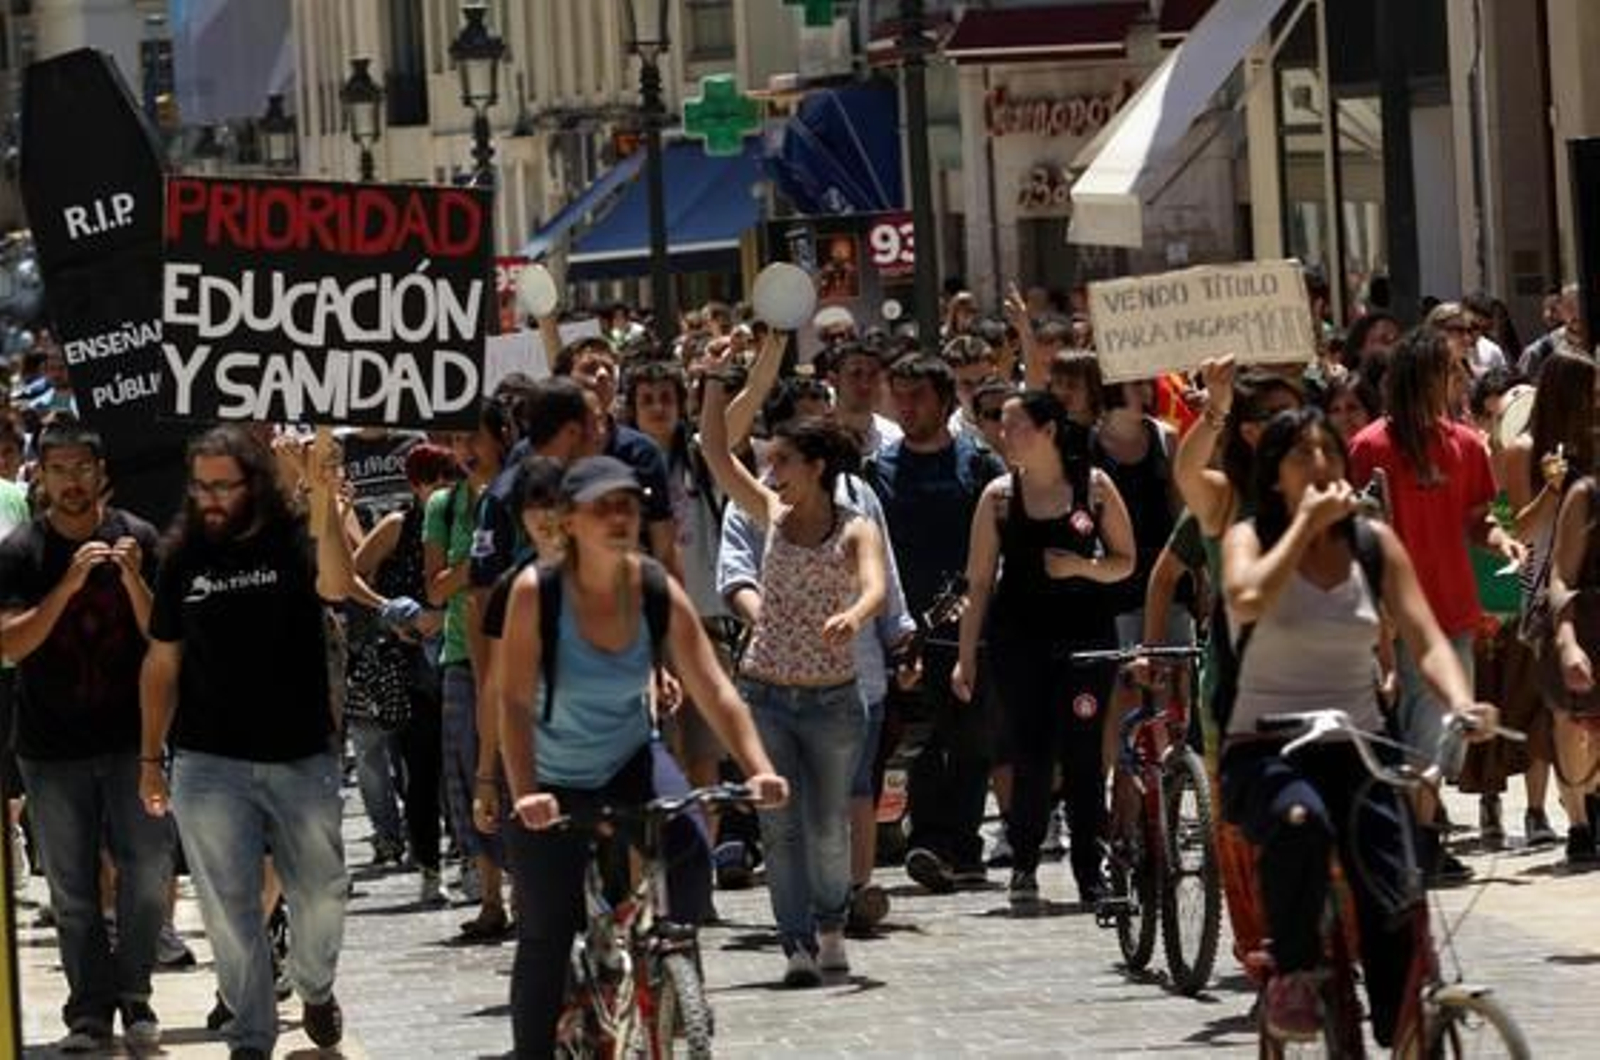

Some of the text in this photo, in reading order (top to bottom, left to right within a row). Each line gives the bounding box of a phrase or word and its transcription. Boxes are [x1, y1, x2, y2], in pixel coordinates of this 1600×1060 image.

[166, 181, 482, 256] PRIORIDAD
[163, 258, 484, 347] EDUCACIÓN
[1103, 273, 1278, 314] VENDO TÍTULO
[1104, 324, 1168, 352] PARA
[1175, 314, 1243, 343] PAGAR
[92, 372, 162, 408] PÚBLI
[161, 344, 479, 423] Y SANIDAD
